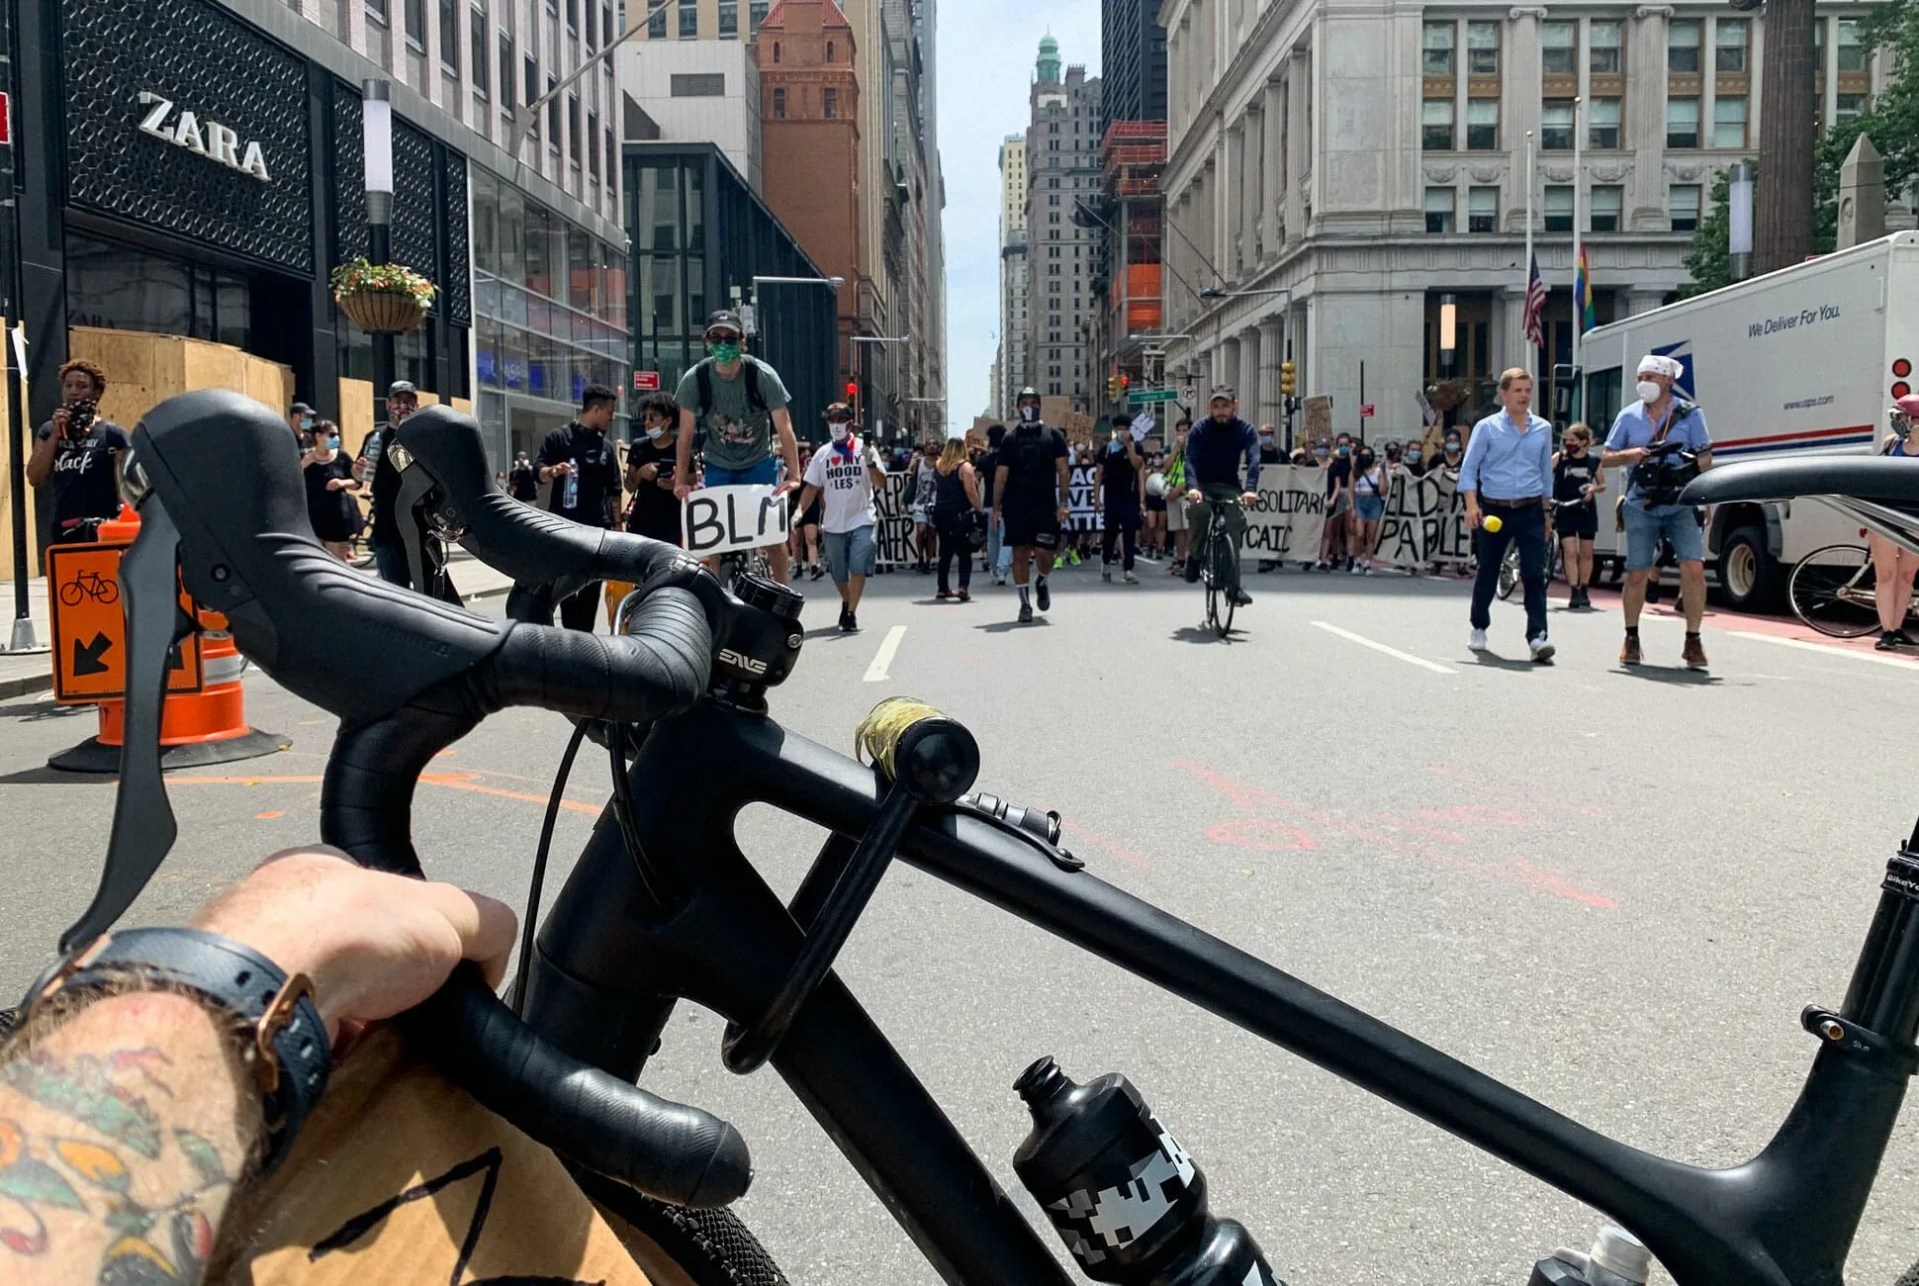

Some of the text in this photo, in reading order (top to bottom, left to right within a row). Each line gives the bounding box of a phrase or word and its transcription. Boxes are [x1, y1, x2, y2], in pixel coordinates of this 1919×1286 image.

[138, 91, 272, 182] ZARA
[1748, 322, 1763, 338] We
[1764, 316, 1799, 335] Deliver
[1800, 309, 1818, 326] For
[826, 466, 862, 480] HOOD
[834, 478, 853, 490] LES
[686, 493, 786, 551] BLM
